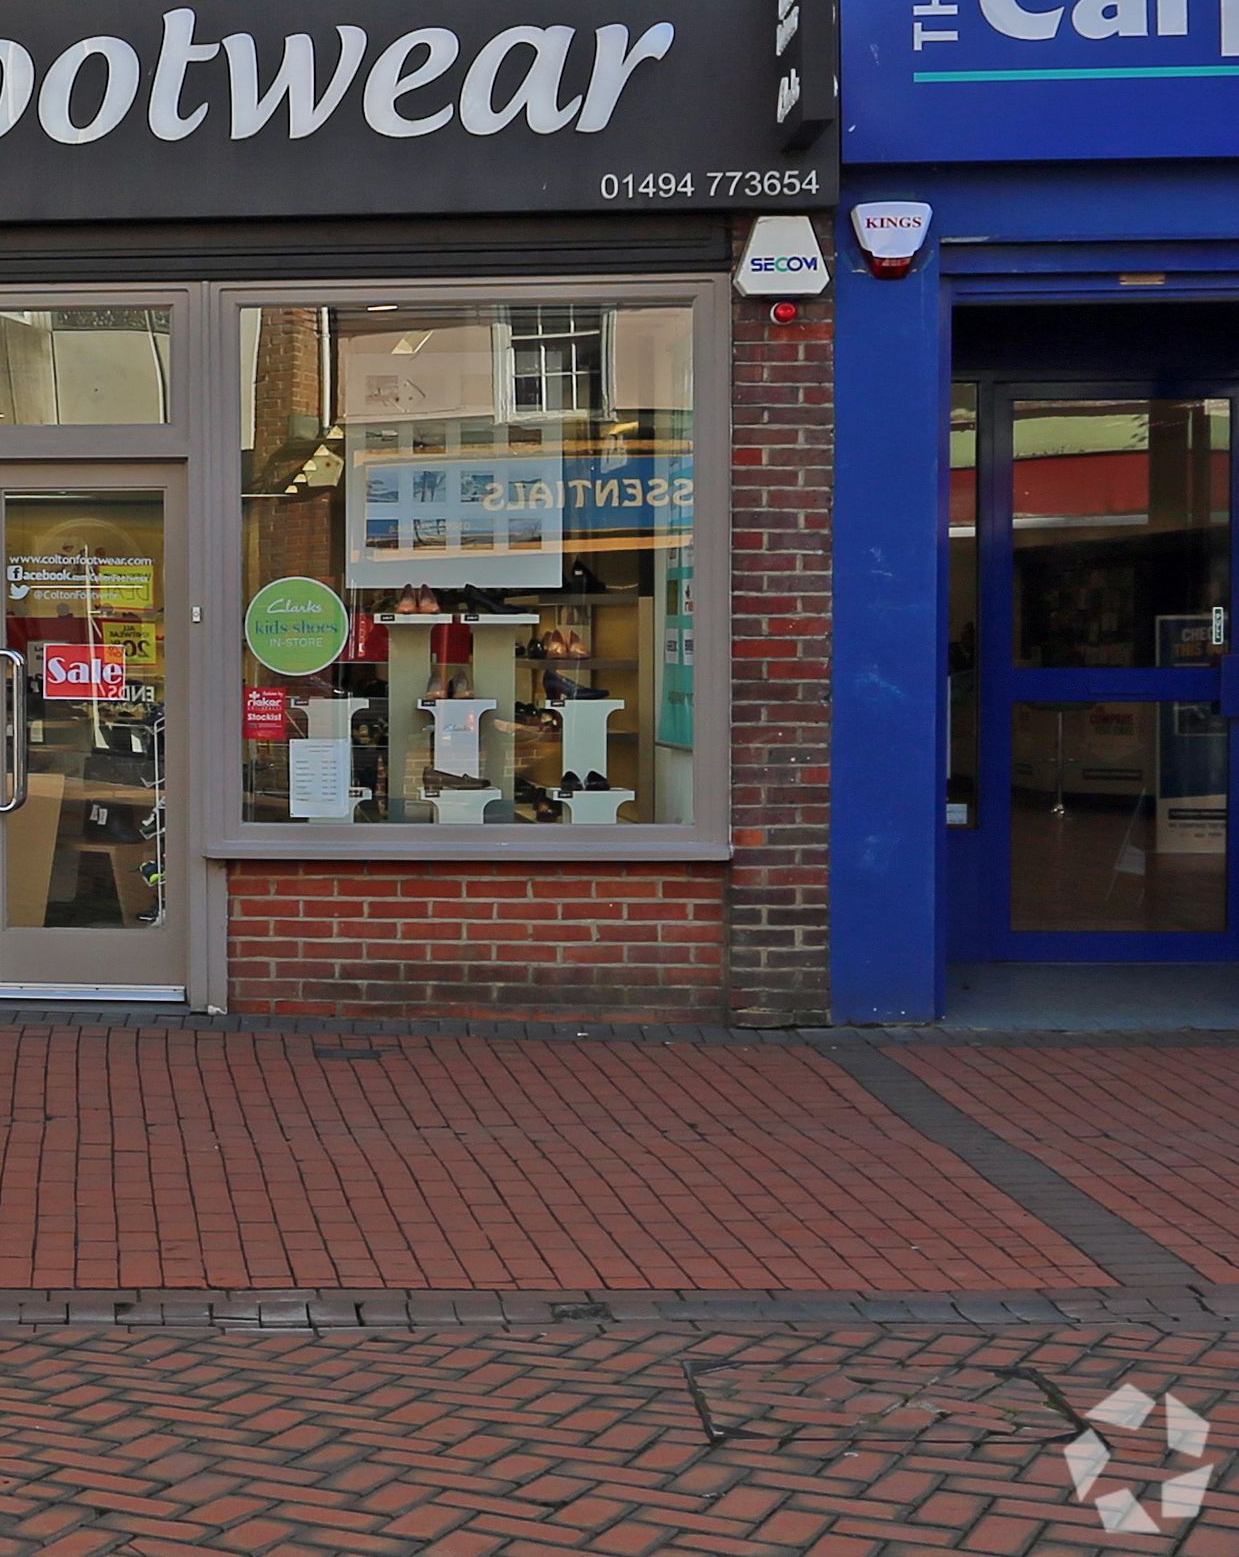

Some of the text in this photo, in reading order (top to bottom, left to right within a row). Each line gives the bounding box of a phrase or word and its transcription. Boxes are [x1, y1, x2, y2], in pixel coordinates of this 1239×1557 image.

[600, 169, 820, 199] 01494 773654
[865, 216, 923, 230] KINGS
[750, 257, 818, 272] SECOM
[9, 555, 152, 567] www.coltonfootwear.com
[267, 598, 322, 613] Clarks
[255, 620, 338, 634] kids shoes
[269, 637, 324, 648] IN-STORE
[47, 657, 123, 684] Sale
